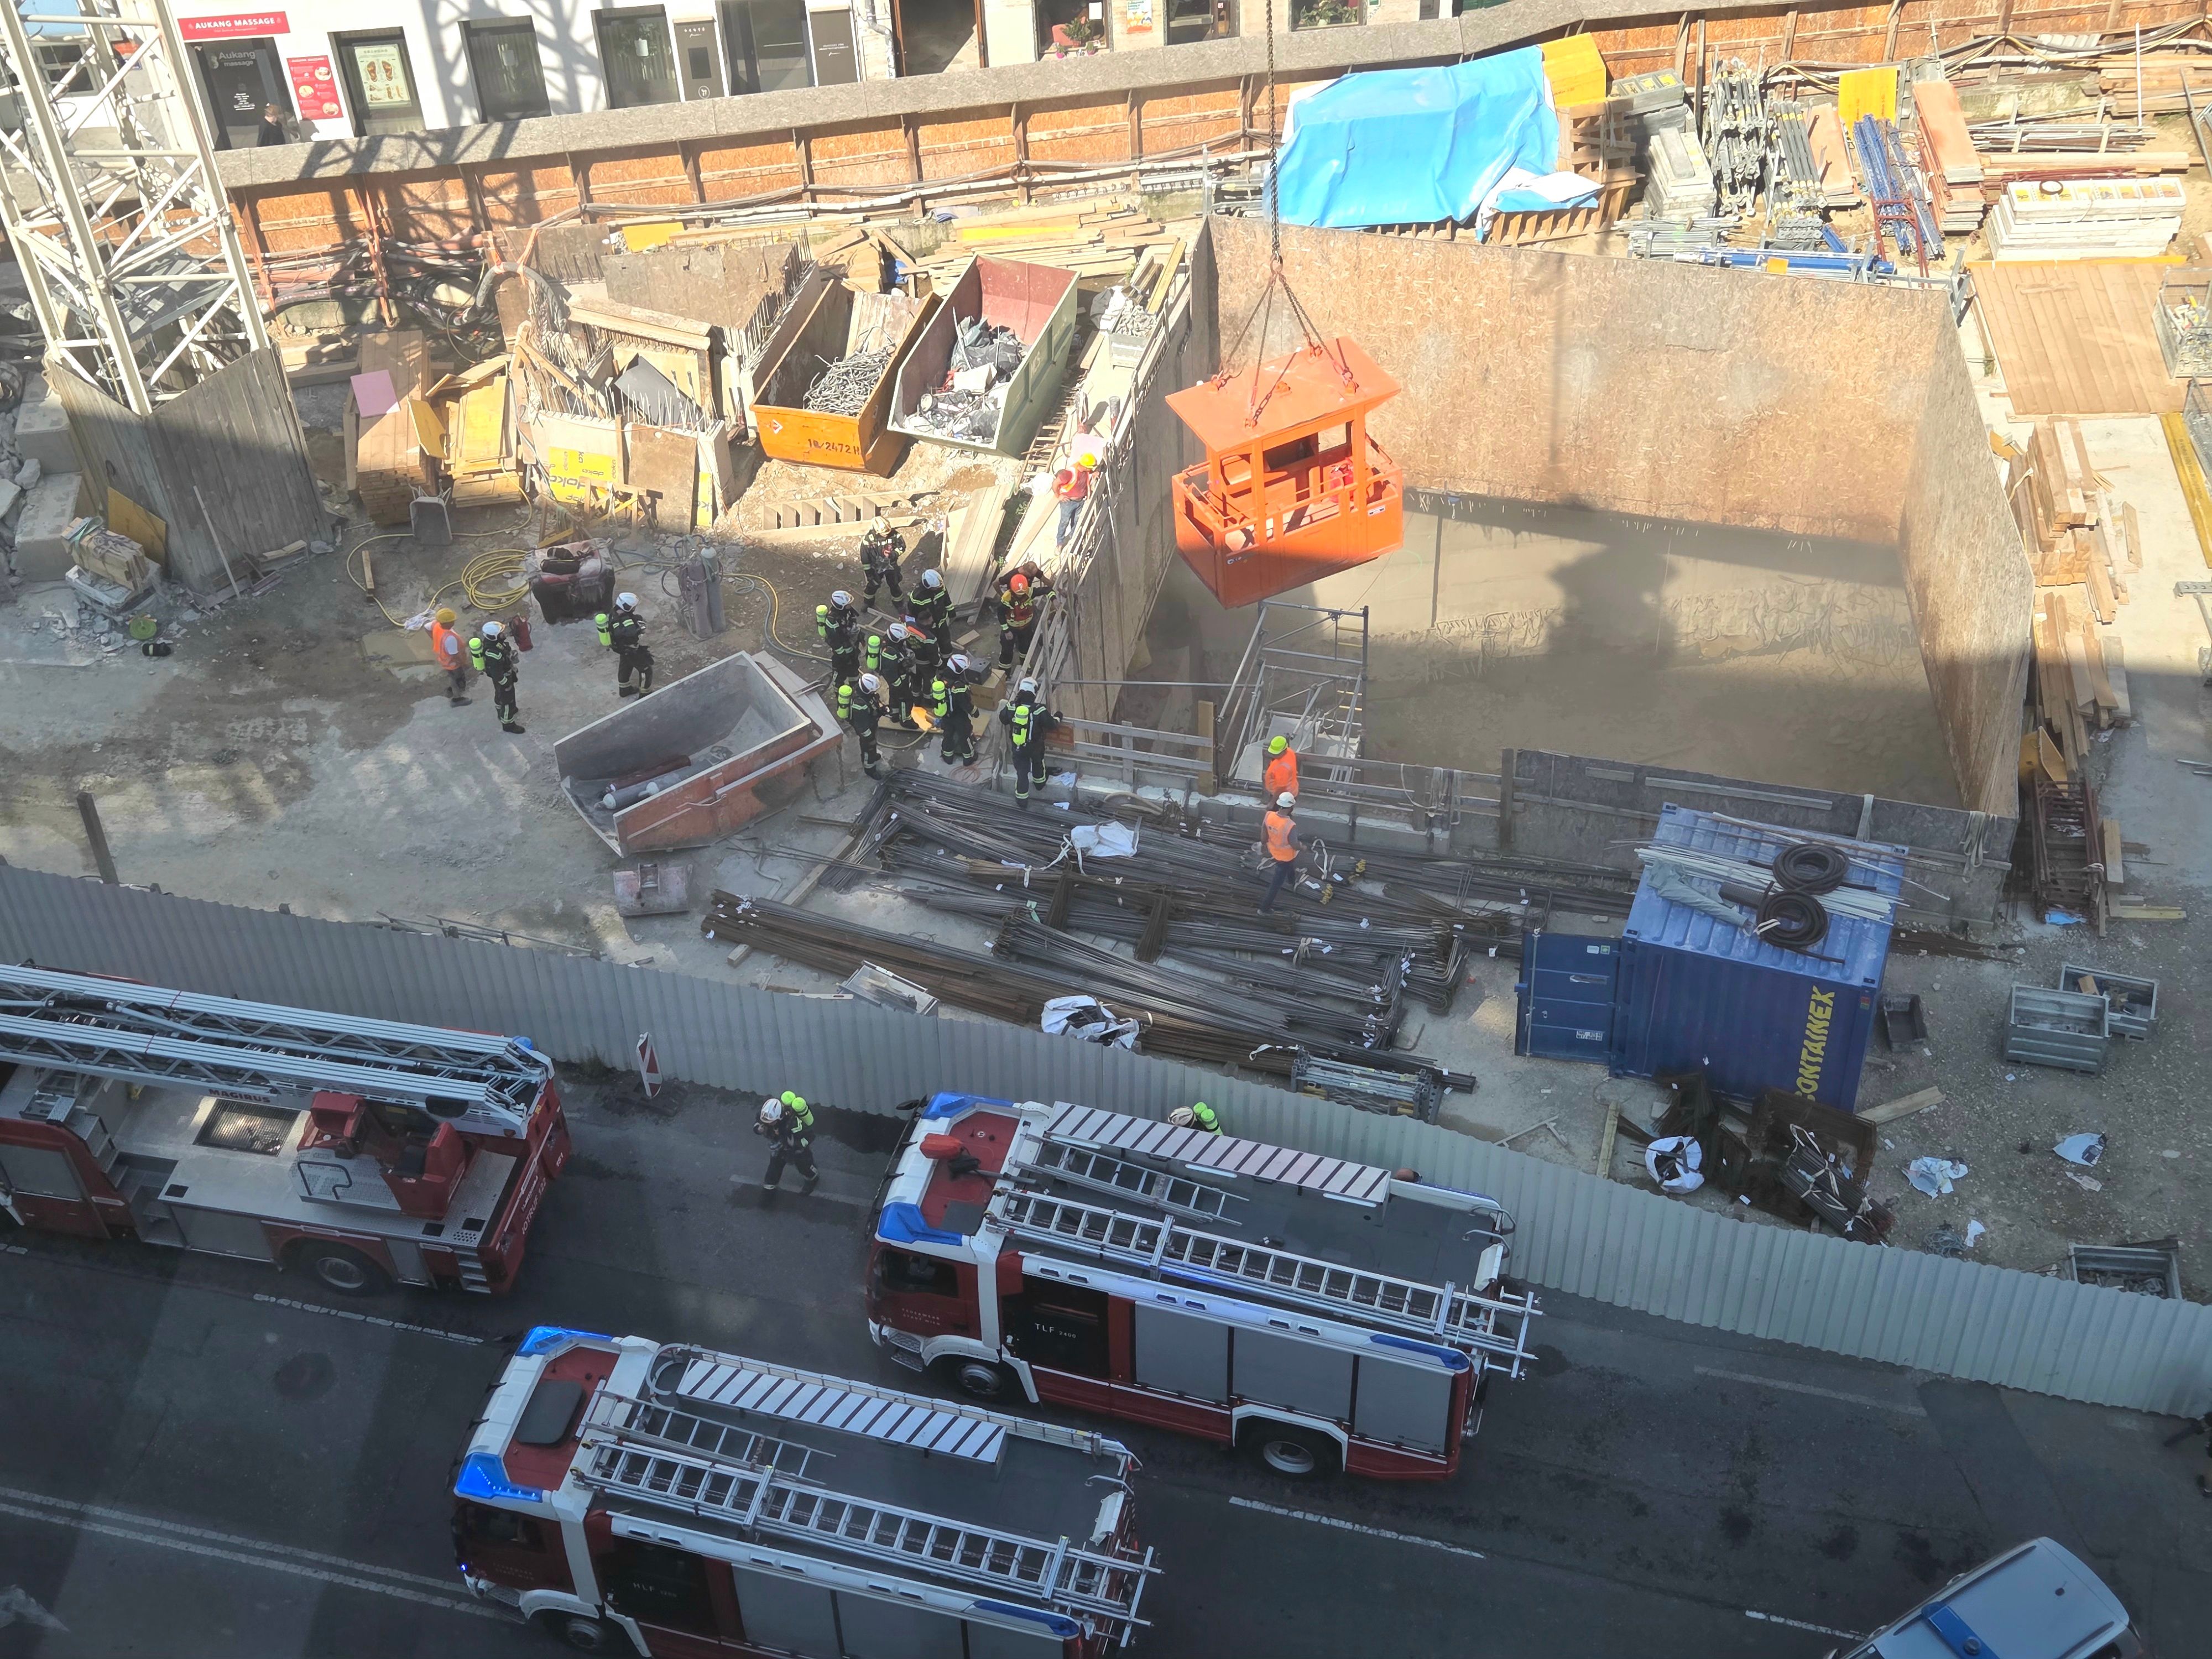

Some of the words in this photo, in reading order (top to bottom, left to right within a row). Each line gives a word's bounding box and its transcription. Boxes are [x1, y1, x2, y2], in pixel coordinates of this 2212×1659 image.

[195, 20, 232, 29] AUKANG
[234, 18, 275, 27] MASSAGE
[219, 51, 255, 60] Aukang
[582, 468, 604, 477] doka
[208, 1088, 271, 1103] MAGIRUS
[1035, 1323, 1055, 1333] TLF
